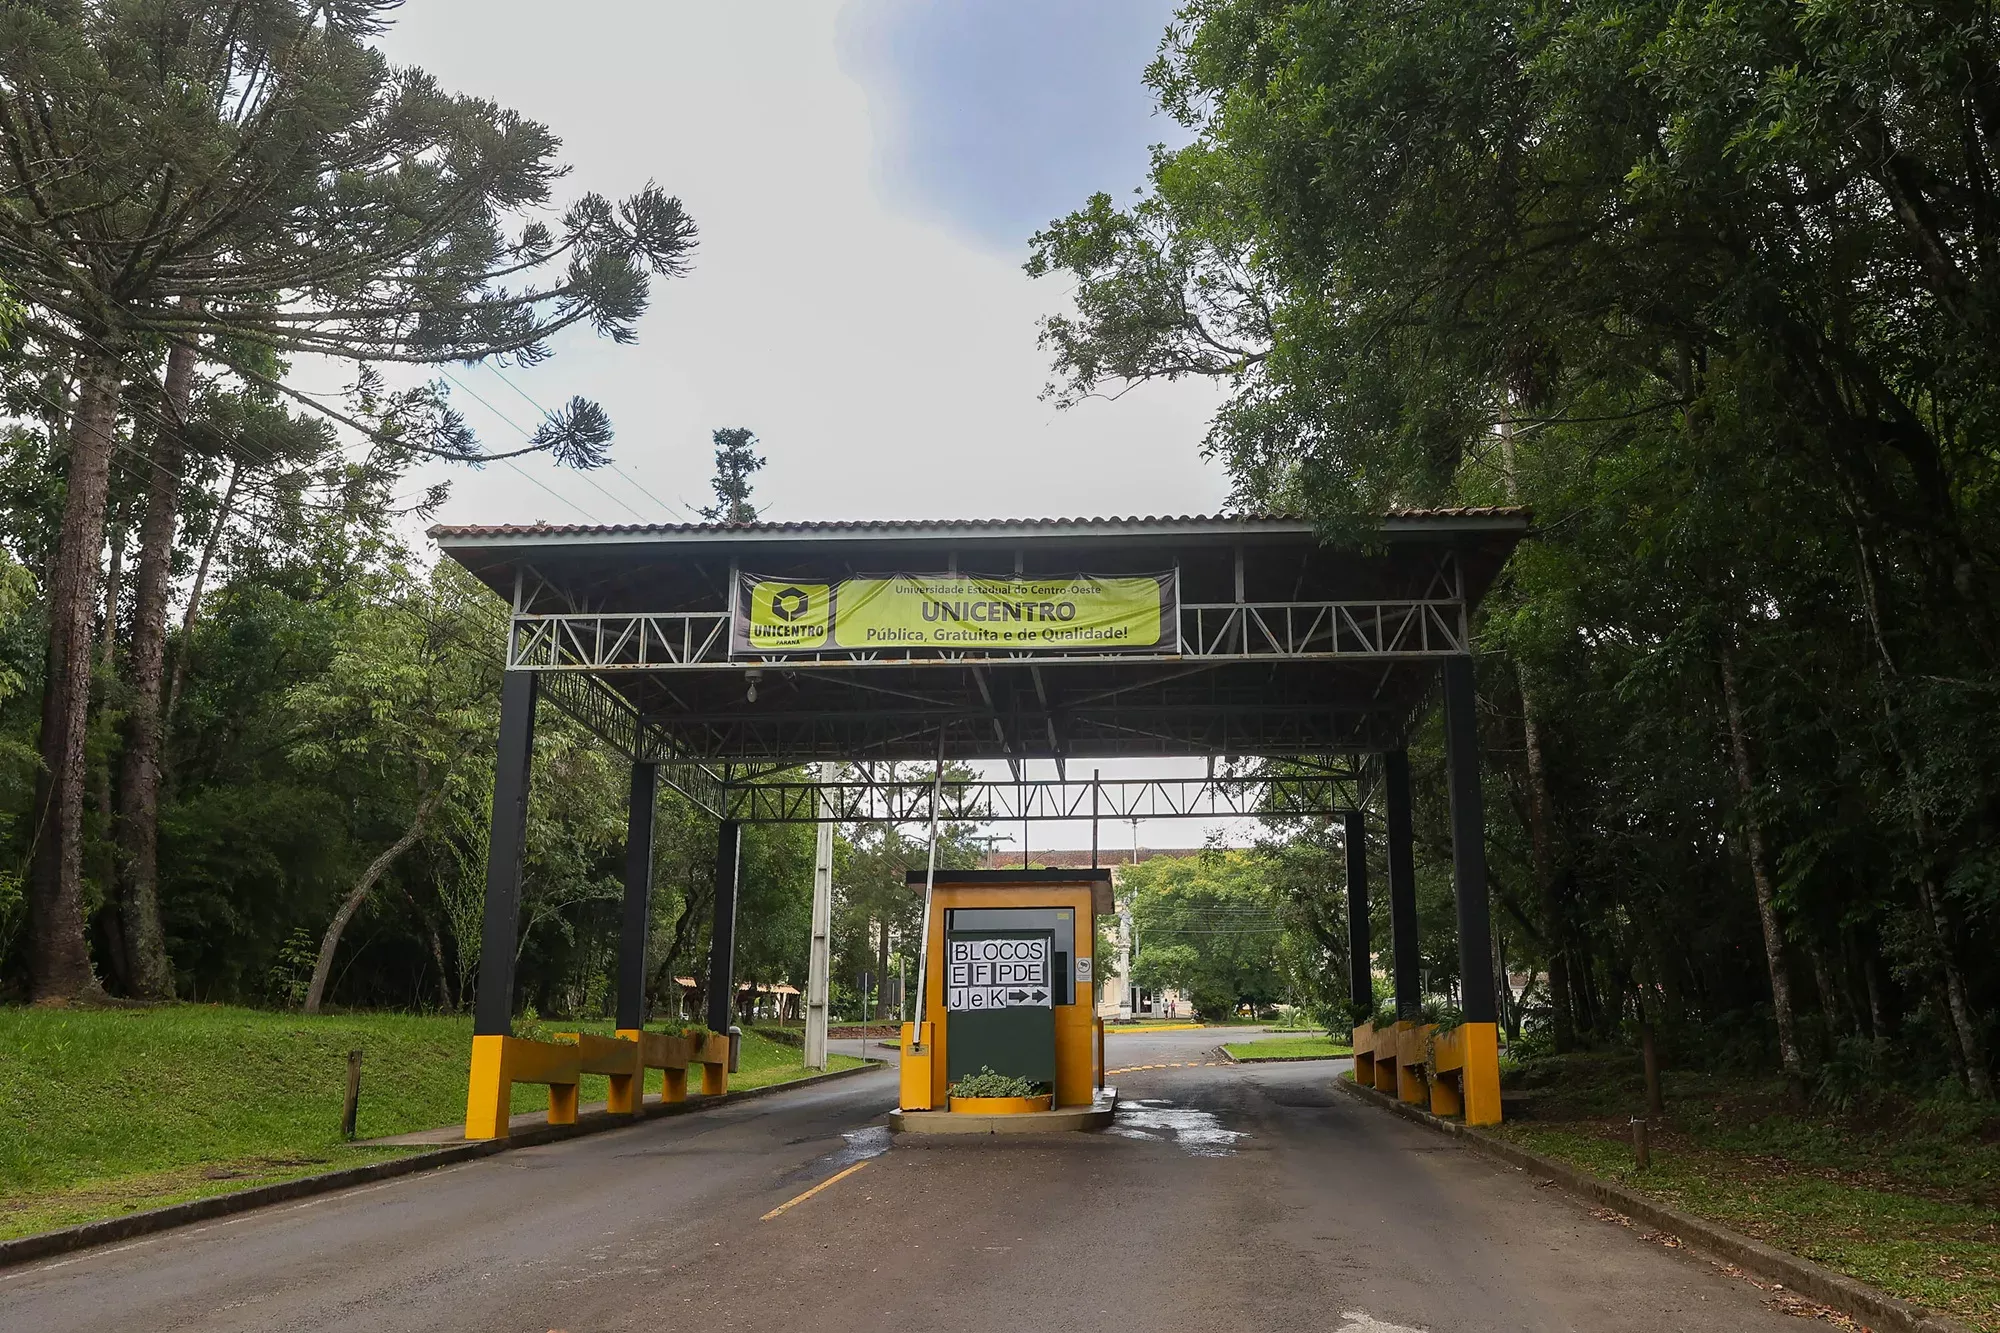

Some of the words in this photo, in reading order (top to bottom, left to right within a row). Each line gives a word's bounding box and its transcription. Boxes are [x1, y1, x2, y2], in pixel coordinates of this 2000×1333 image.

[895, 584, 964, 595] Universidade
[967, 584, 1011, 595] Estadual
[1015, 585, 1028, 595] do
[1030, 585, 1102, 595] Centro-Oeste
[922, 601, 1076, 622] UNICENTRO
[754, 624, 824, 638] UNICENTRO
[866, 627, 928, 643] Pública,
[933, 628, 998, 641] Gratuita
[1003, 631, 1013, 641] e
[1017, 628, 1037, 641] de
[1041, 626, 1129, 643] Qualidade!
[955, 942, 1043, 961] BLOCOS
[953, 966, 966, 984] E
[976, 965, 988, 983] F
[999, 964, 1041, 982] PDE
